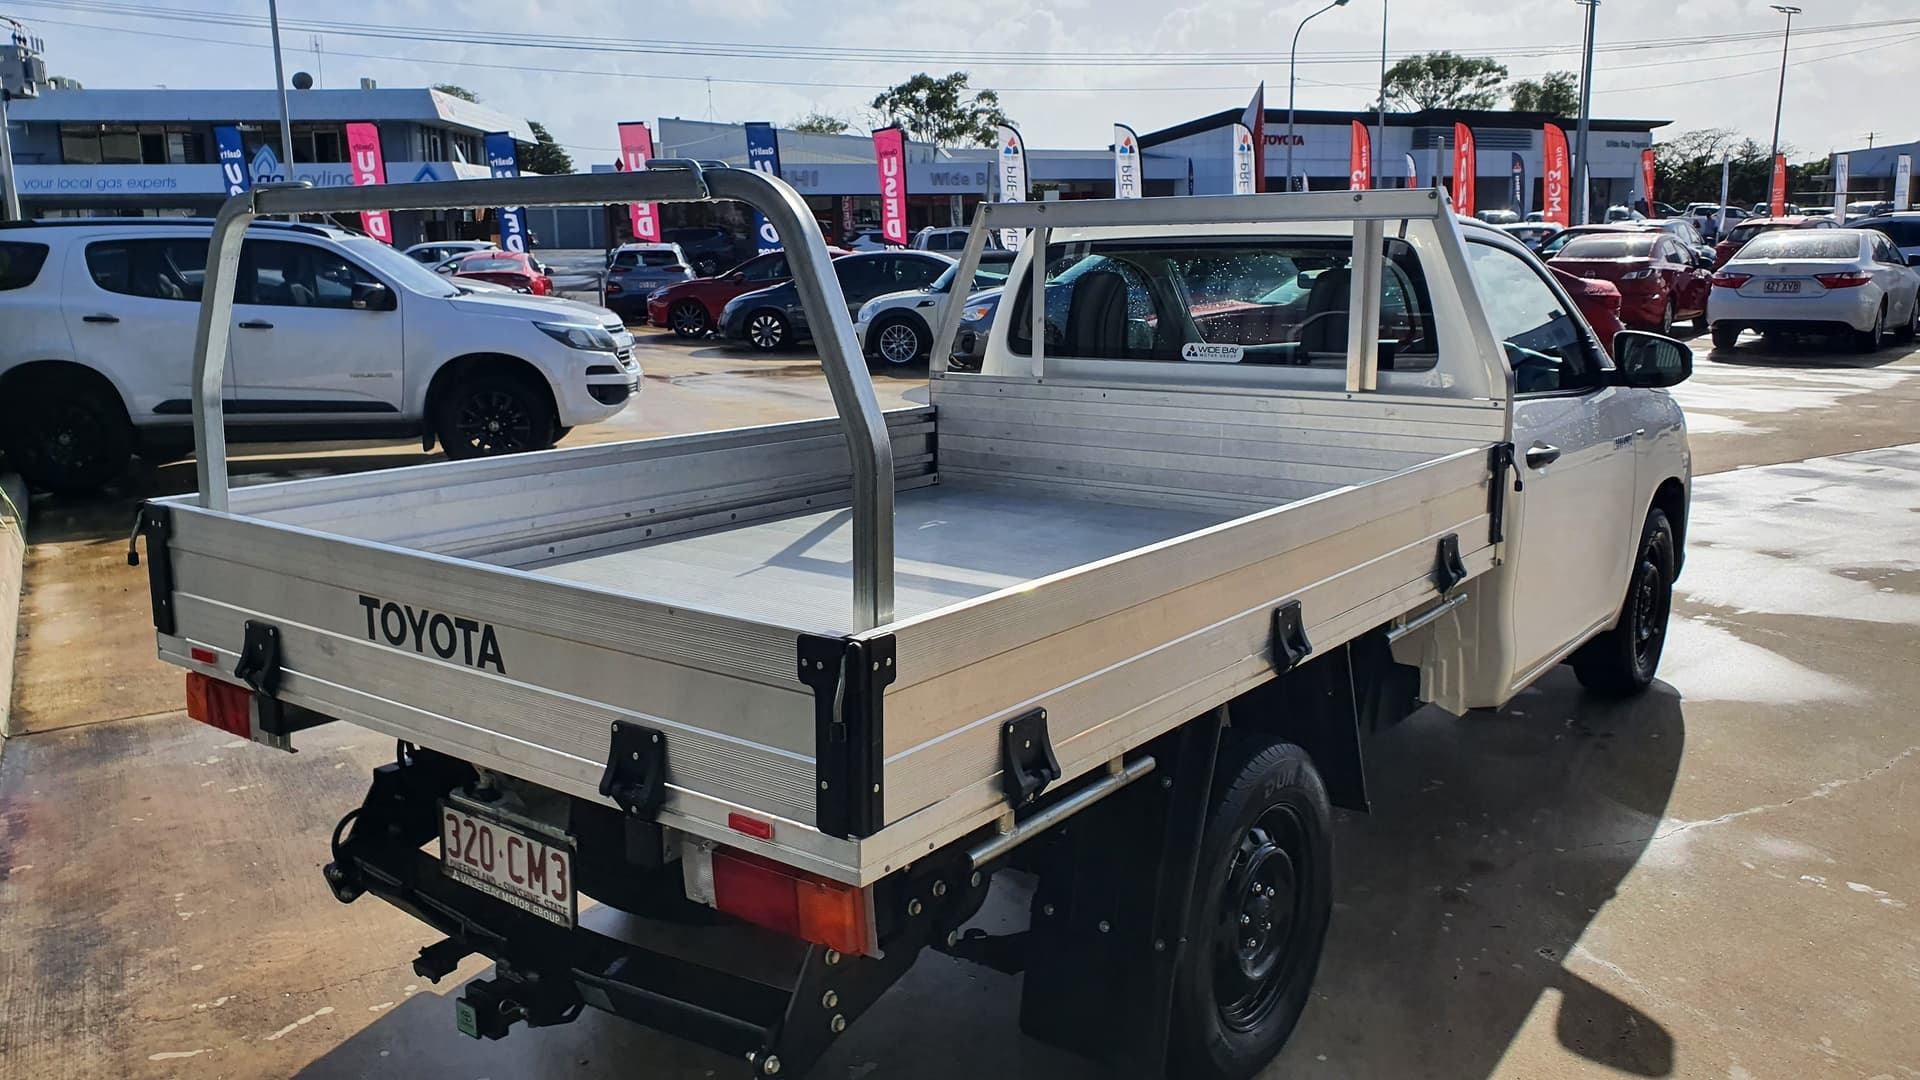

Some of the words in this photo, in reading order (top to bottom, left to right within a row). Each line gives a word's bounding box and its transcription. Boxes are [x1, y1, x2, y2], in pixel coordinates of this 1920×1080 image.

[23, 178, 53, 190] your
[57, 177, 92, 189] local
[96, 179, 122, 191] gas
[127, 176, 177, 190] experts
[930, 172, 970, 187] Wide
[359, 594, 506, 675] TOYOTA
[502, 892, 530, 912] MOTOR
[533, 905, 561, 924] GROUP
